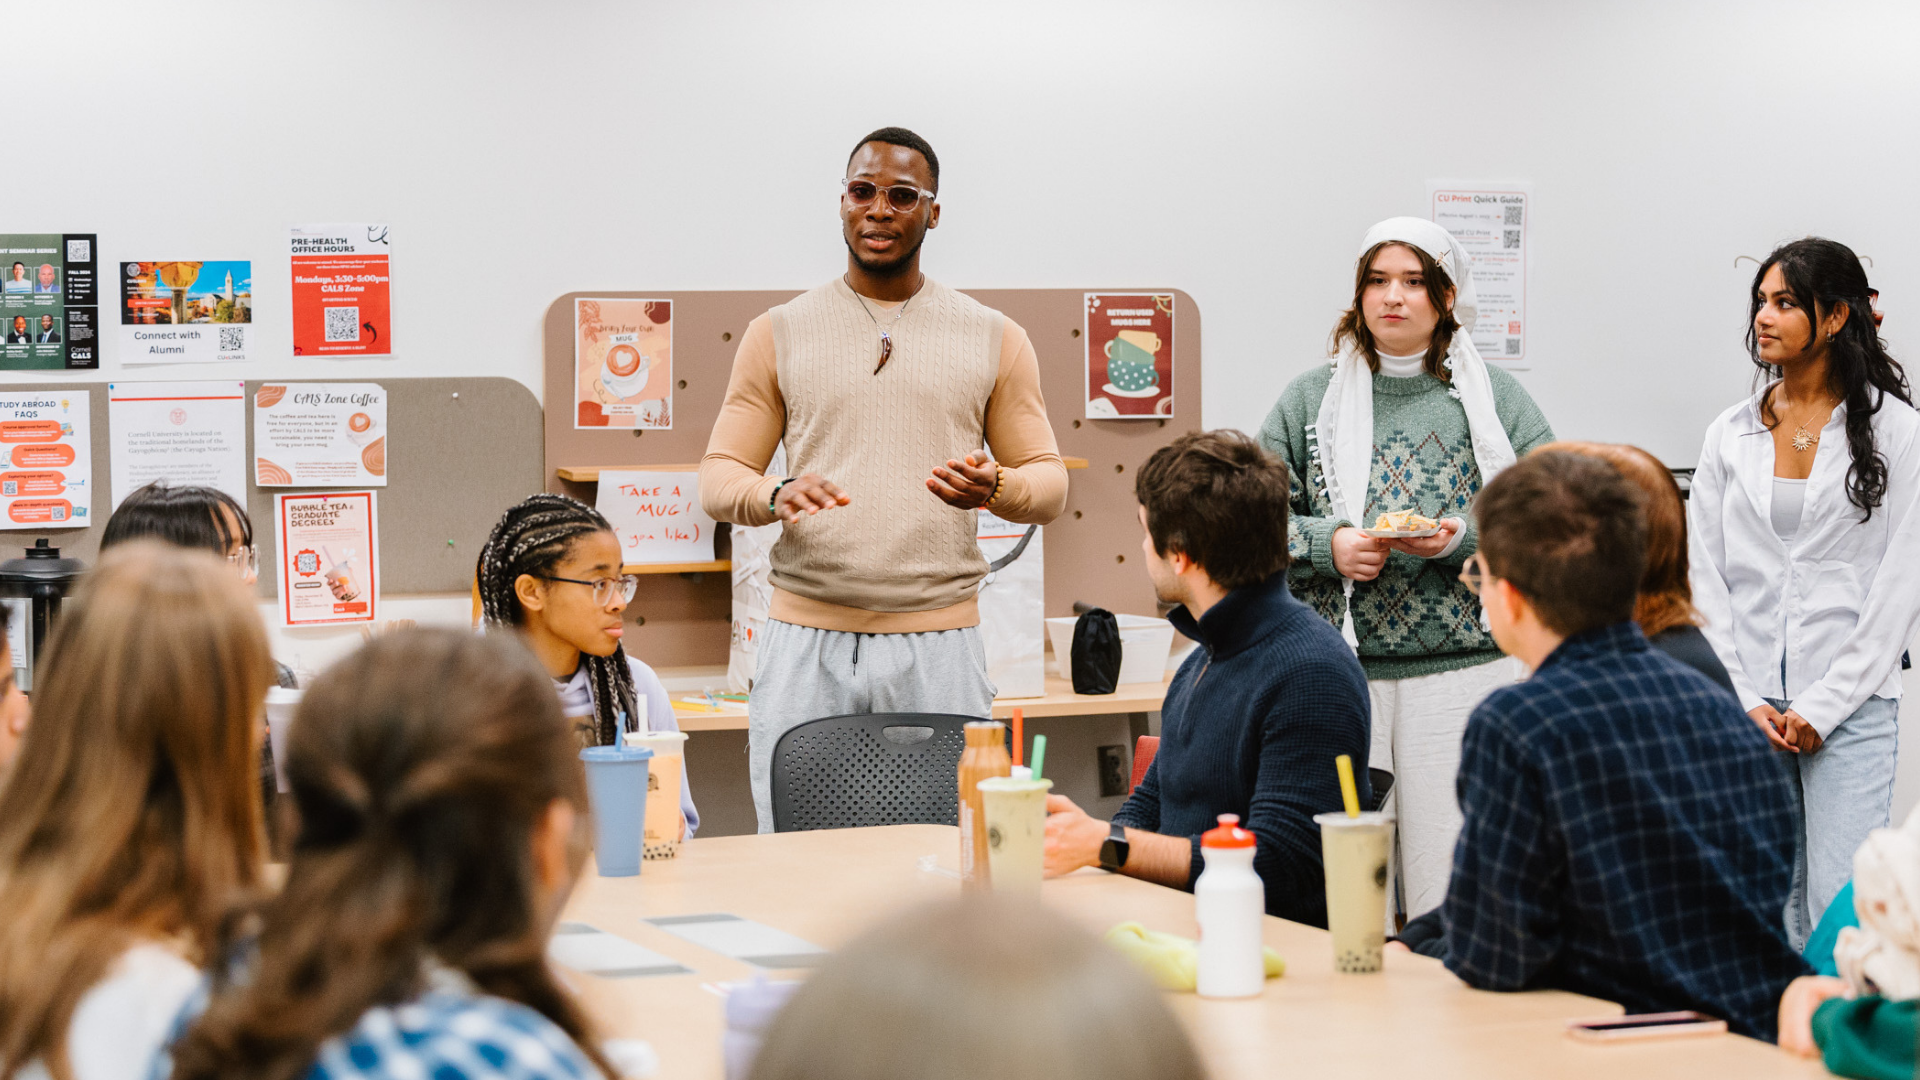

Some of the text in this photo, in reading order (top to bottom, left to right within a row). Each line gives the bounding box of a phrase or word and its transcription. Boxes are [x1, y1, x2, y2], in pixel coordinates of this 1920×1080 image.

[1452, 195, 1472, 203] Print
[1474, 195, 1497, 204] Quick
[1500, 196, 1523, 204] Guide
[295, 275, 389, 284] Mondays, 3:30-5:00pm
[134, 331, 201, 340] Connect with
[149, 345, 185, 354] Alumni
[324, 393, 348, 404] Zone
[350, 393, 379, 406] Coffee
[618, 484, 681, 497] TAKE A
[291, 504, 327, 512] BUBBLE
[636, 501, 691, 517] MUG!
[291, 511, 340, 519] GRADUATE
[291, 519, 334, 527] DEGREES
[628, 523, 699, 548] you like)
